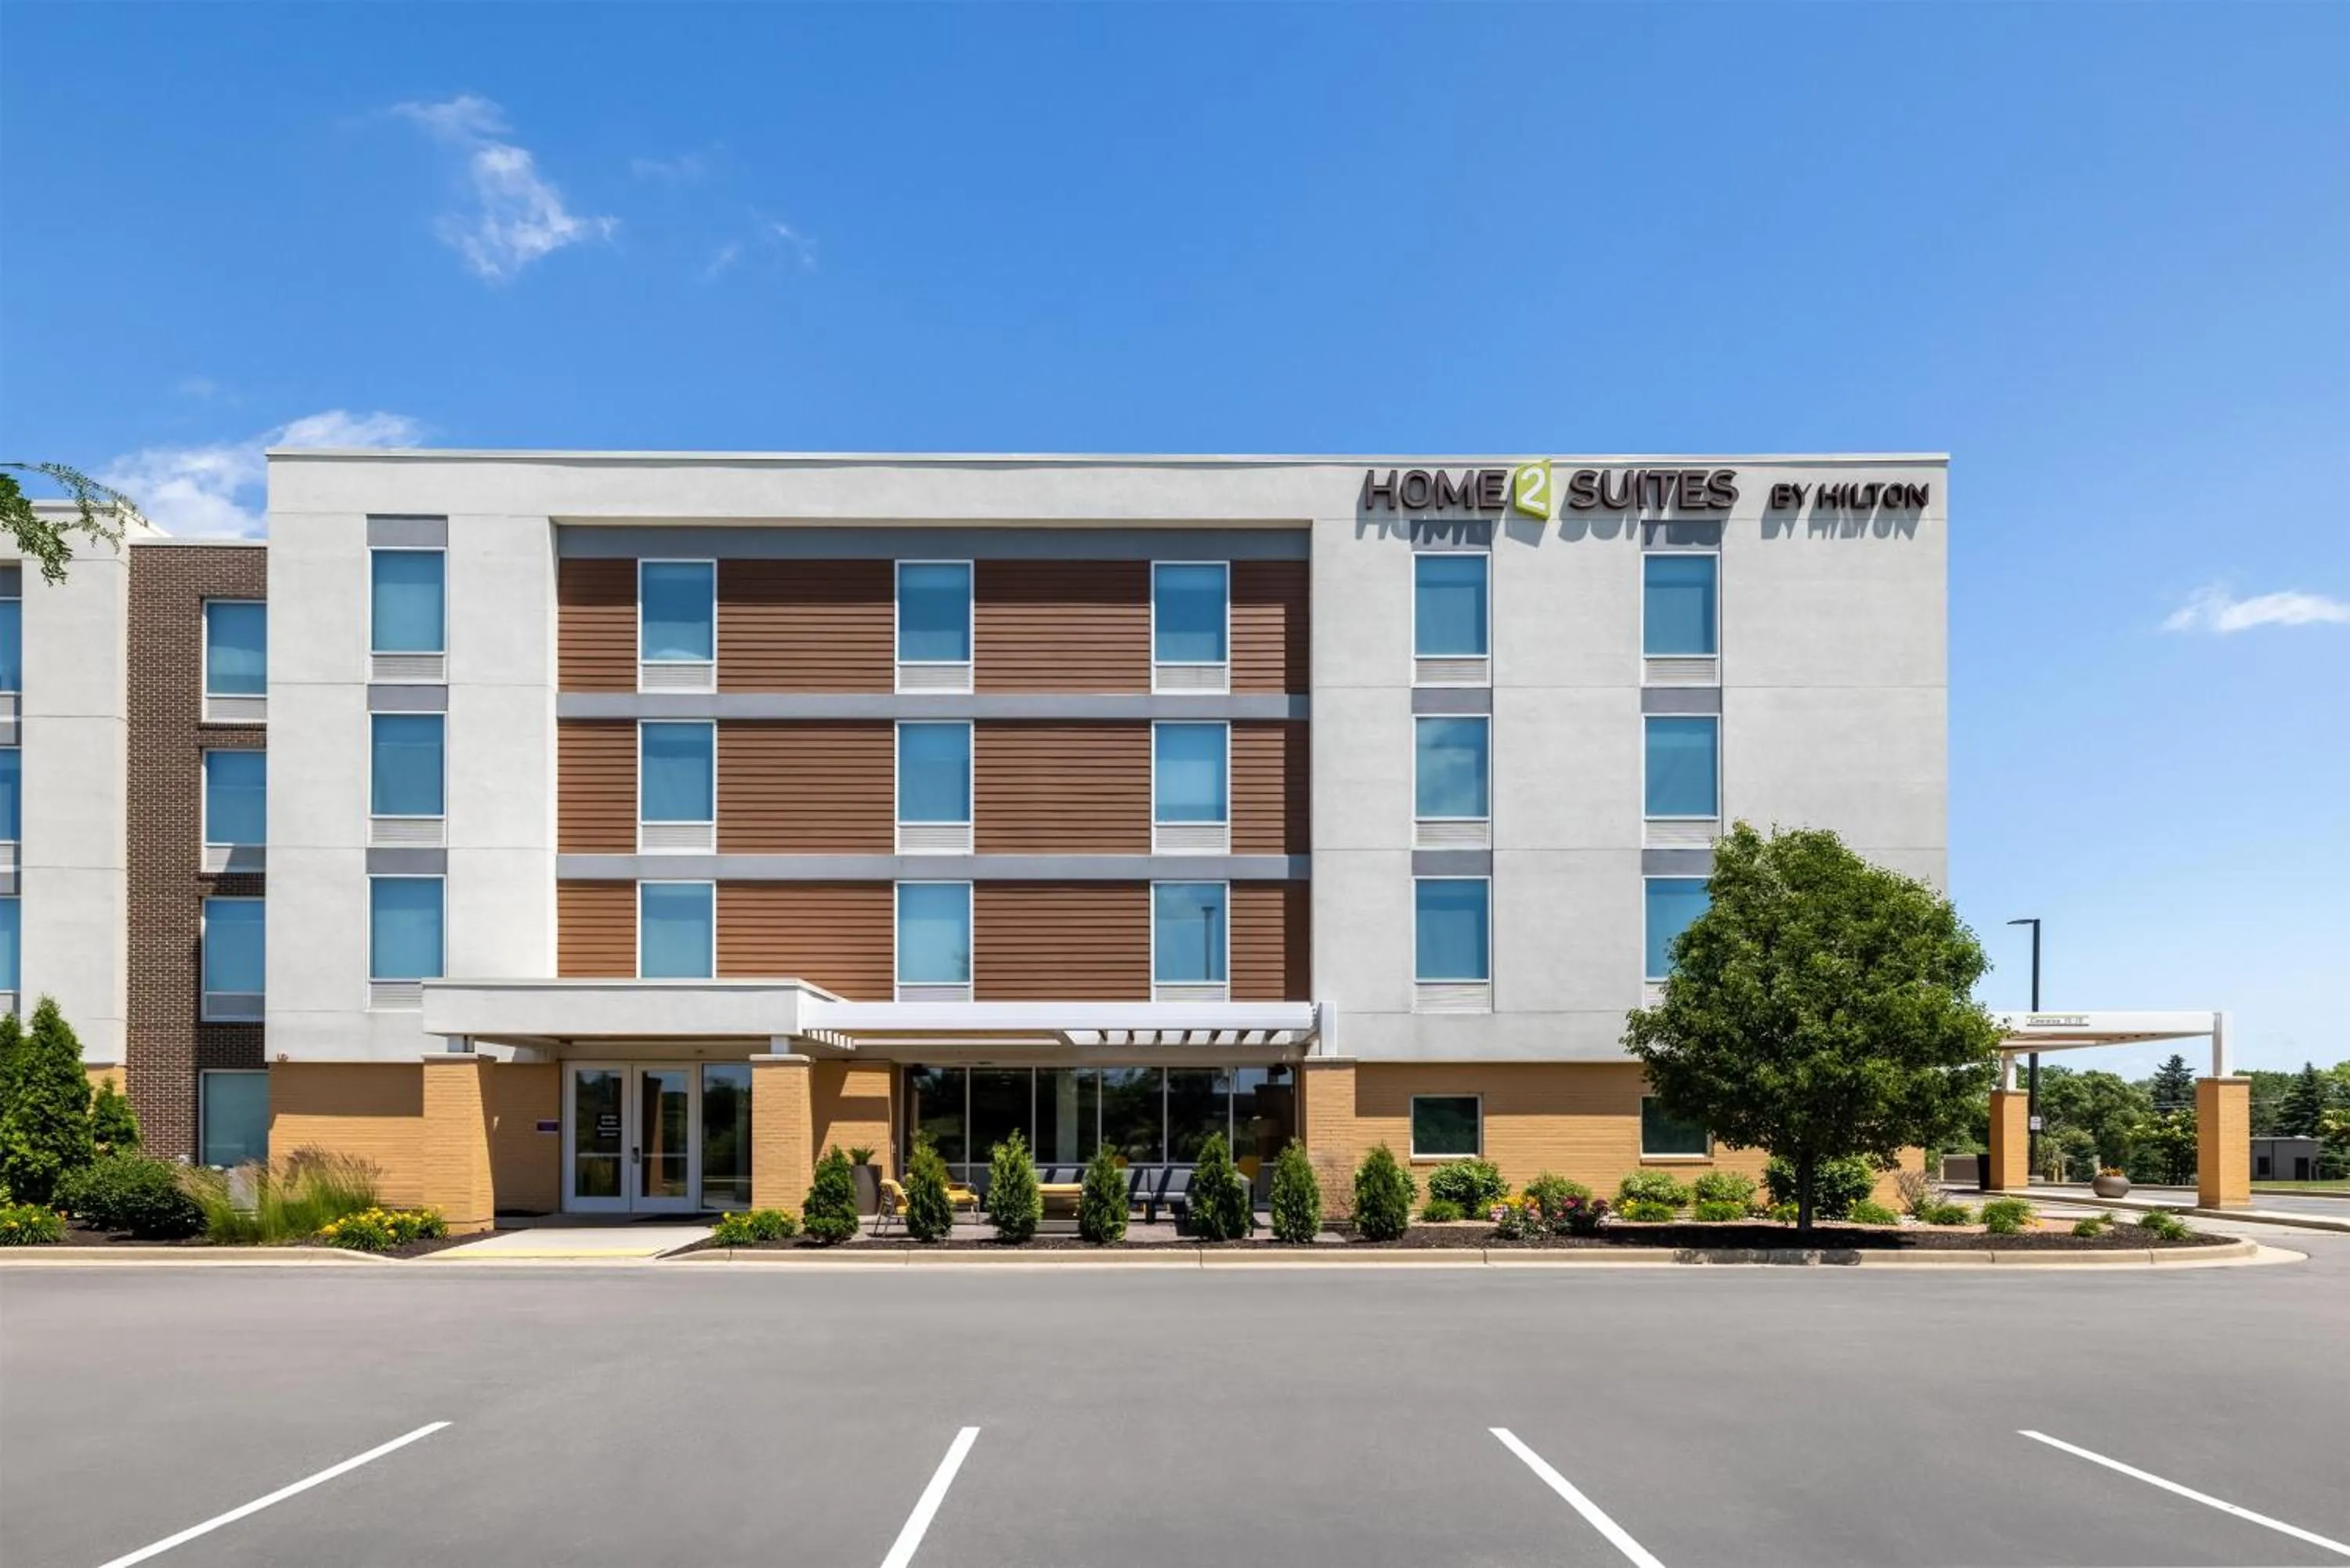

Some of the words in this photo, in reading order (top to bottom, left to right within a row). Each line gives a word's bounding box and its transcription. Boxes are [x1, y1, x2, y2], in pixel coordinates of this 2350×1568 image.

[1569, 469, 1740, 509] SUITES
[1771, 482, 1811, 509] BY
[1817, 482, 1929, 509] HILTON
